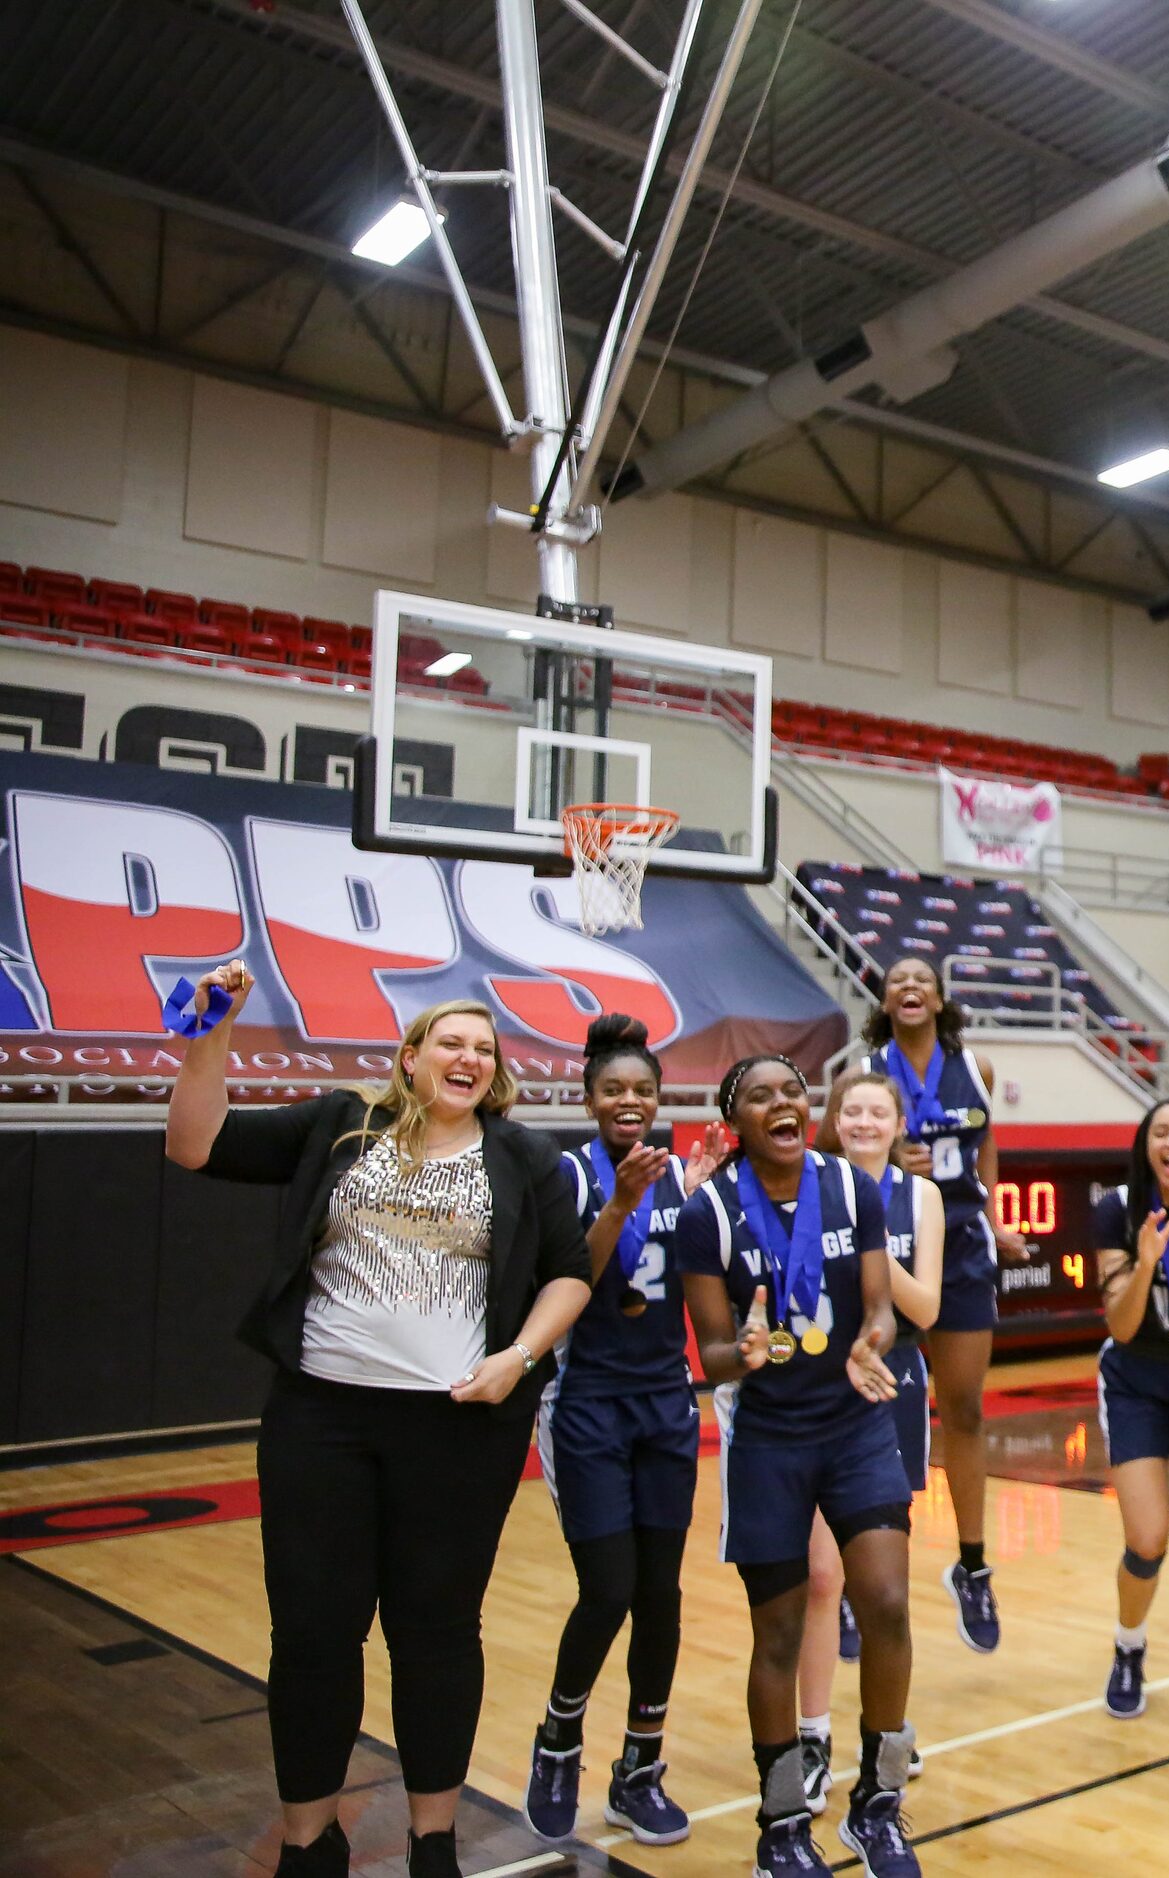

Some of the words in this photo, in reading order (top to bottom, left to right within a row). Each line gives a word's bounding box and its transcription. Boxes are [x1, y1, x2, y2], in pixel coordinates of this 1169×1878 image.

[0, 790, 684, 1051] PPS
[0, 1045, 334, 1072] OCIAION
[1002, 1262, 1051, 1294] period
[1062, 1253, 1084, 1289] 4
